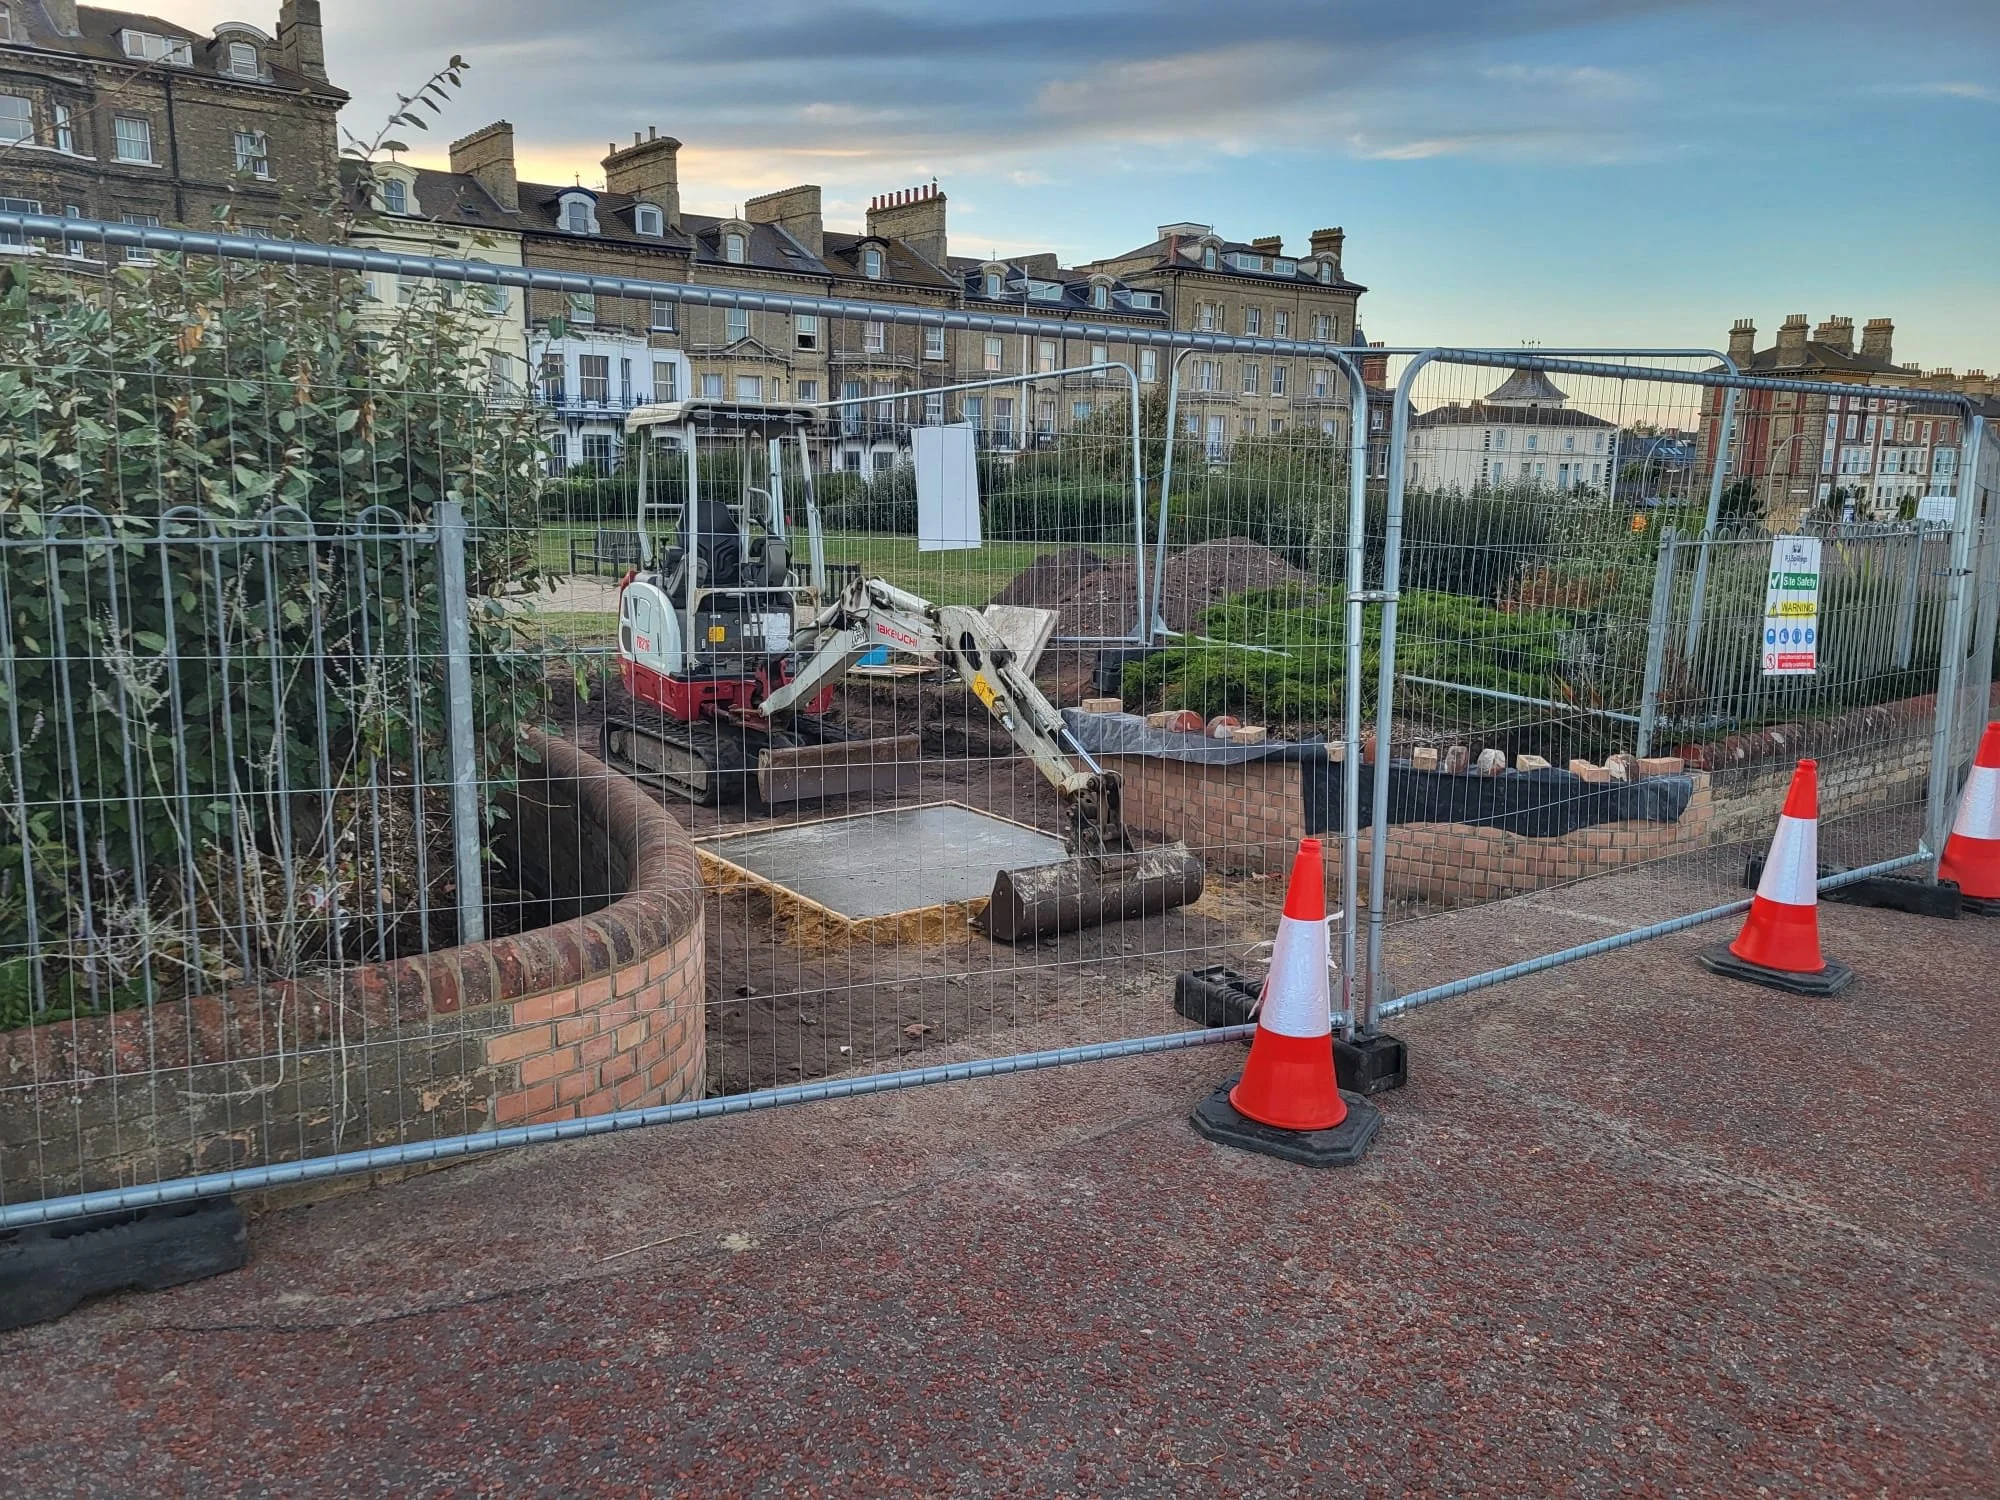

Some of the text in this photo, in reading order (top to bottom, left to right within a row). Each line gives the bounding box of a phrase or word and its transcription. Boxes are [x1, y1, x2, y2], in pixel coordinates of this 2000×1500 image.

[1783, 575, 1816, 589] Ste Safety
[1781, 602, 1814, 612] WARNING
